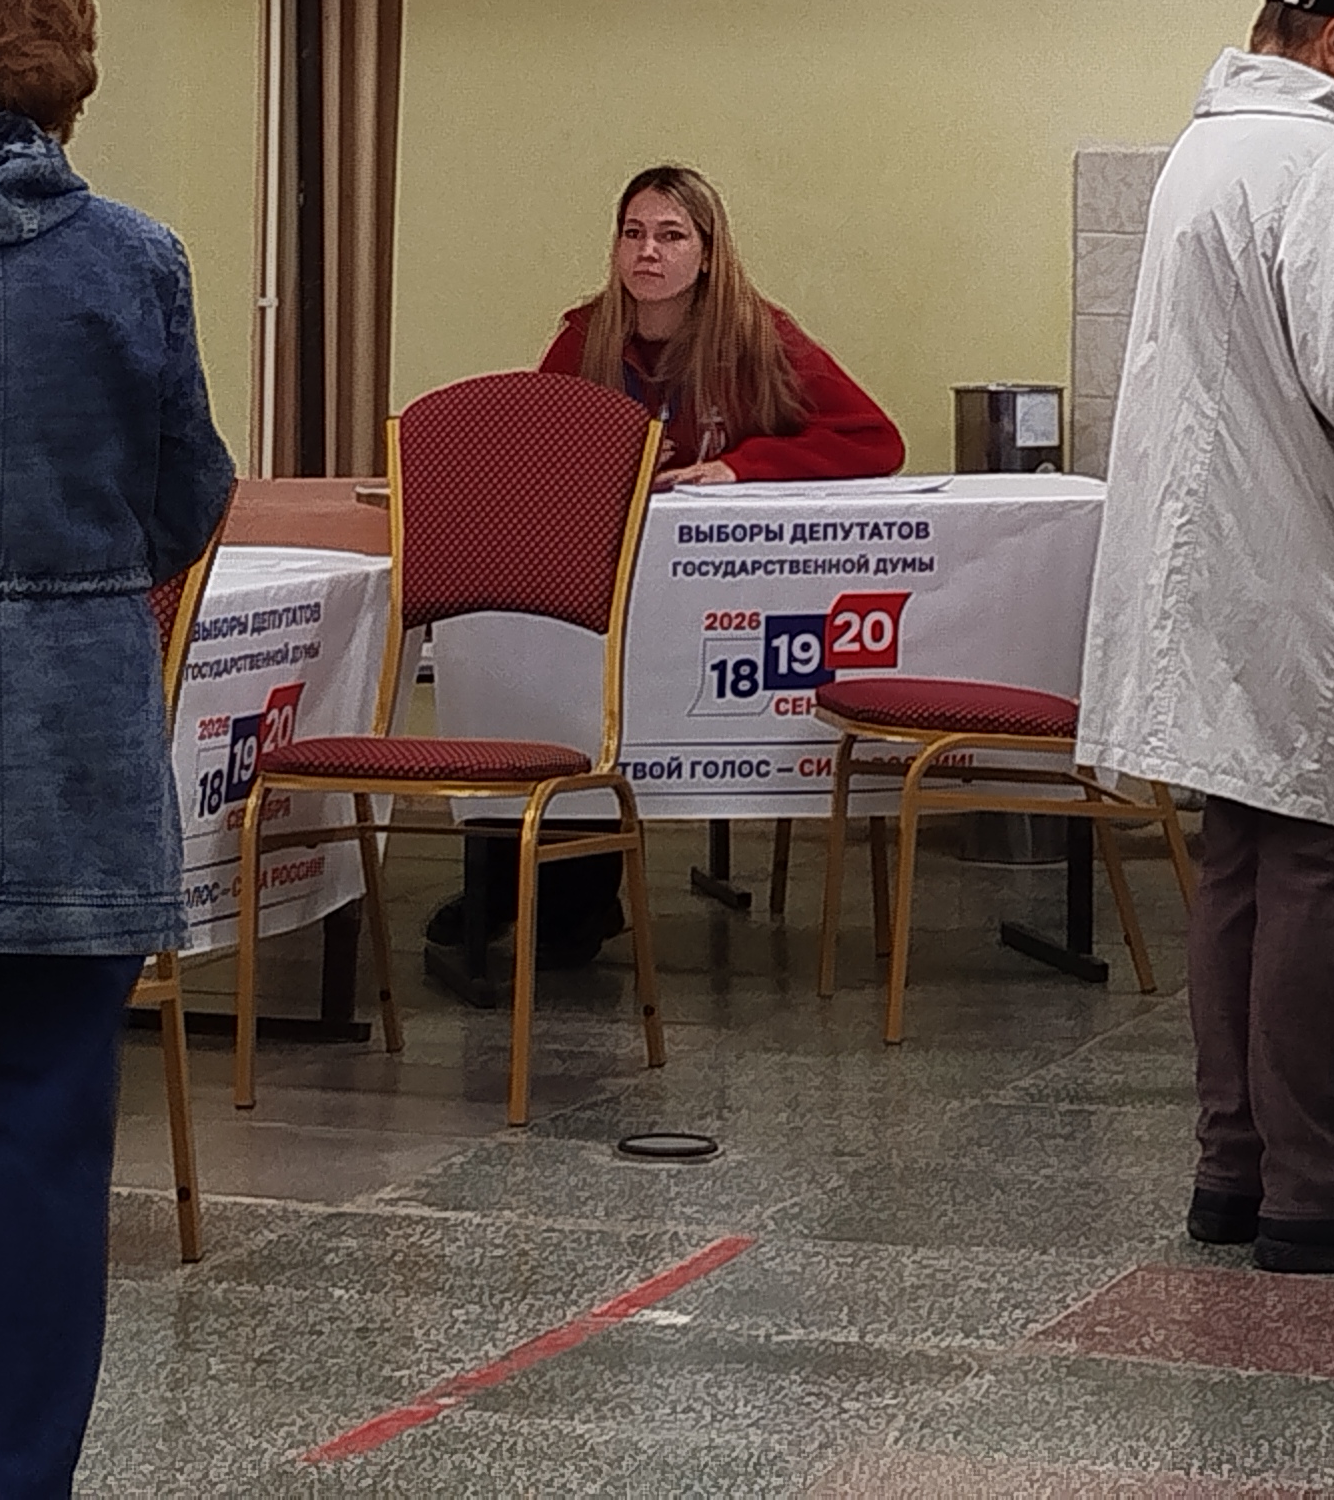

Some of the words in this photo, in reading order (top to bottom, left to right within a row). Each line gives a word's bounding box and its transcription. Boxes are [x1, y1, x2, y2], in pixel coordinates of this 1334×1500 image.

[677, 522, 785, 544] ВЫБОРЫ
[789, 520, 932, 546] ДЕПУТАТОВ
[671, 553, 870, 580] ГОСУДАРСТВЕННОЙ
[873, 555, 936, 577] ДУМЫ
[192, 613, 249, 642] ВЫБОРЫ
[250, 601, 322, 637] ДЕПУТАТОВ
[704, 611, 762, 632] 2026
[709, 657, 759, 699] 18
[770, 632, 823, 676] 19
[832, 610, 894, 653] 20
[198, 769, 225, 819] 18
[233, 735, 259, 785] 19
[262, 705, 295, 755] 20
[618, 756, 683, 781] ТВОЙ
[690, 759, 771, 780] ГОЛОС
